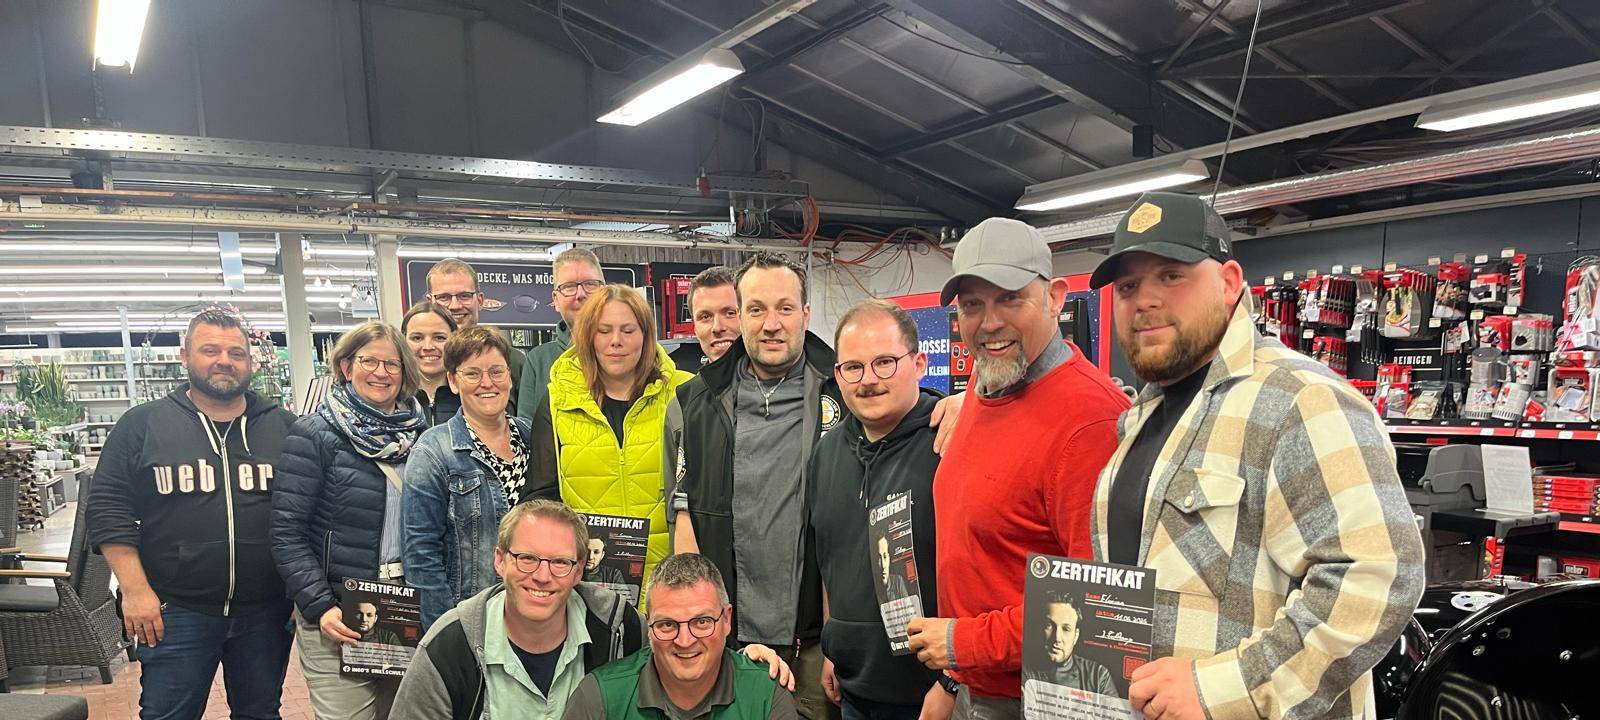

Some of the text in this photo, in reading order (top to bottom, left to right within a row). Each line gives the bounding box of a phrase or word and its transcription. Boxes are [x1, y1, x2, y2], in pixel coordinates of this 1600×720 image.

[478, 273, 511, 285] DECKE,
[512, 274, 533, 284] WAS
[1393, 355, 1432, 365] REINIGEN
[877, 494, 908, 522] ZERTIFIKAT
[587, 515, 645, 530] ZERTIFIKAT
[1050, 560, 1146, 590] ZERTIFIKAT
[358, 581, 415, 598] ZERTIFIKAT
